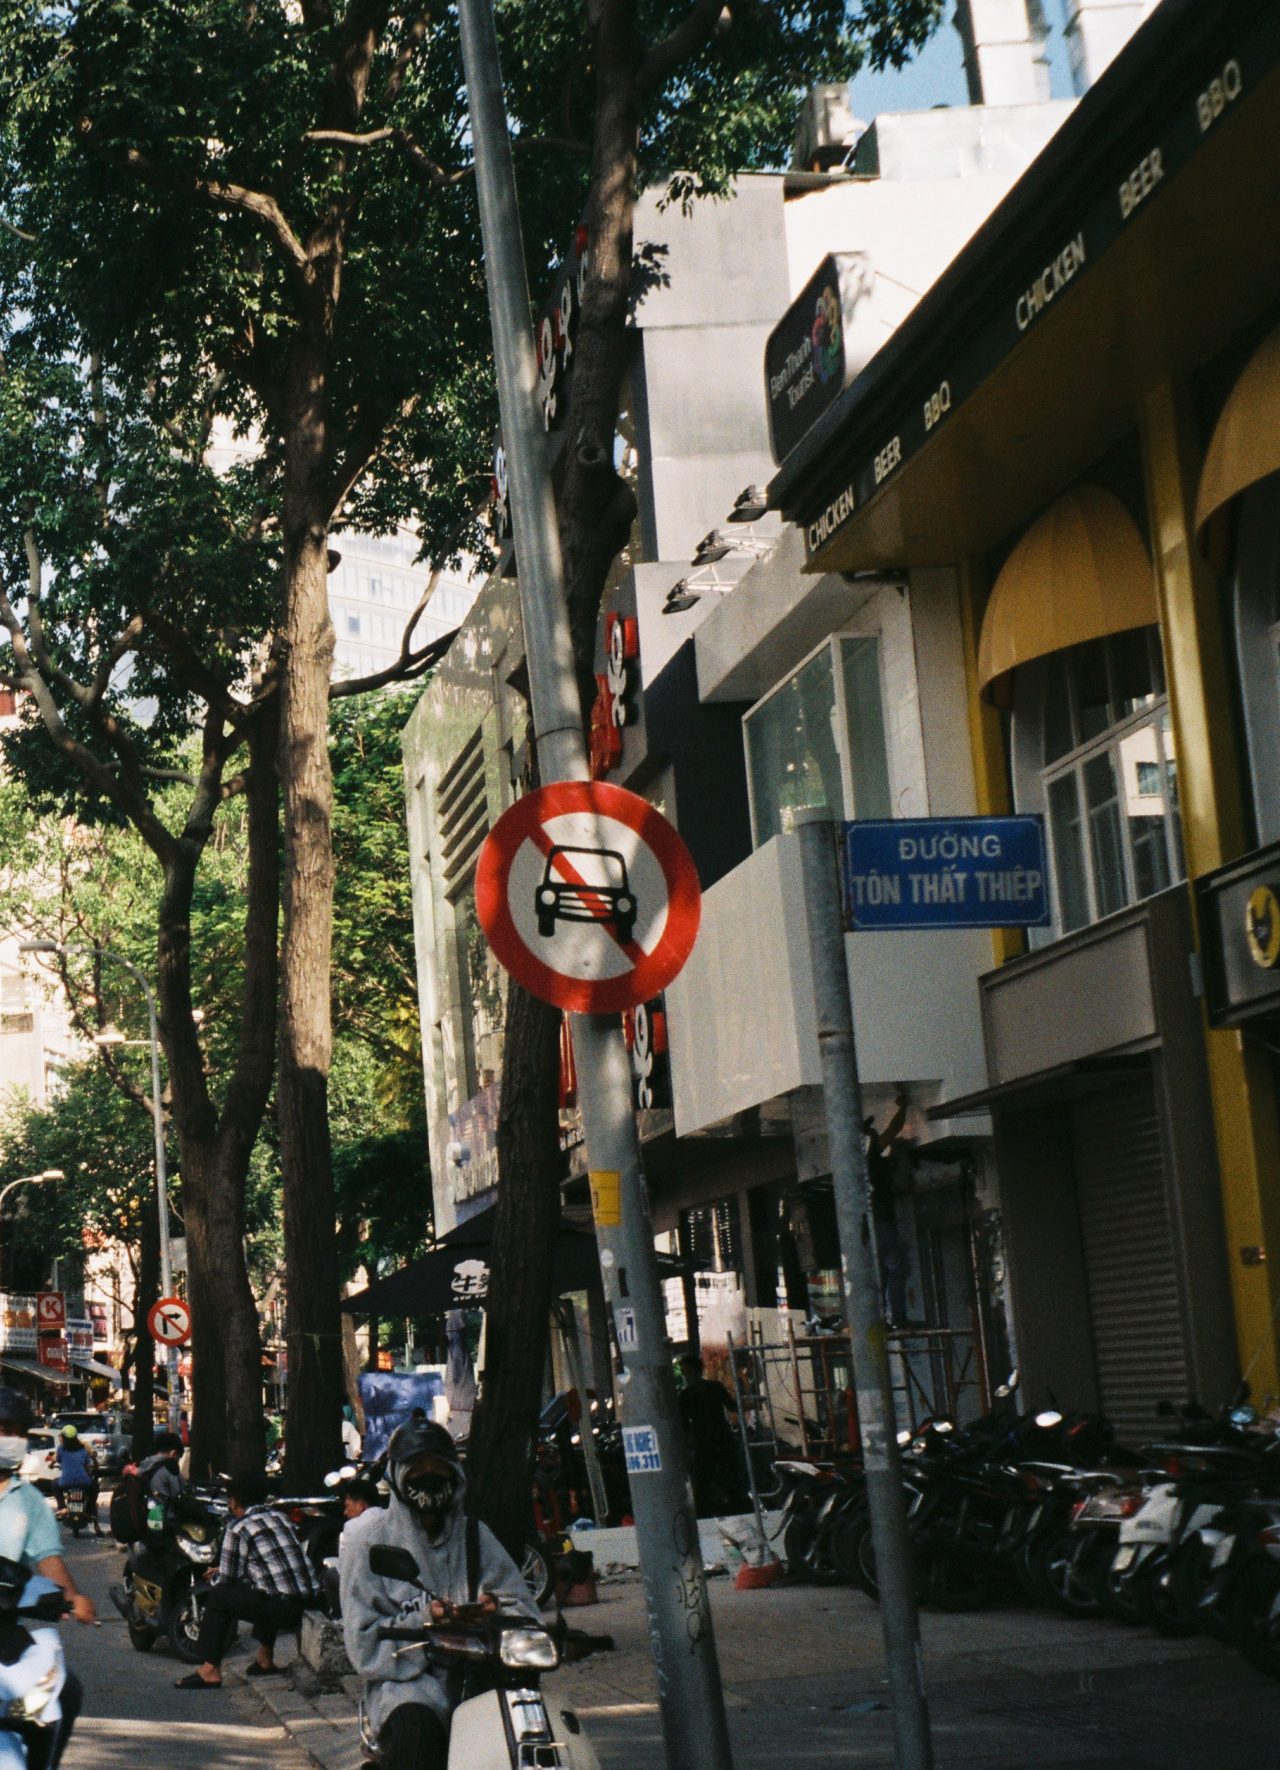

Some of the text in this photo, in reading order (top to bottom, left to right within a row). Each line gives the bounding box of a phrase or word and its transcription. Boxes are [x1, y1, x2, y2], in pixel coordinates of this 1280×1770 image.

[1016, 61, 1242, 331] CHICKEN BEER BBQ
[809, 380, 952, 552] CHICKEN BEER BBQ
[852, 869, 900, 905] TÔN
[908, 864, 967, 904] THẤT
[898, 831, 1002, 860] ĐƯỜNG
